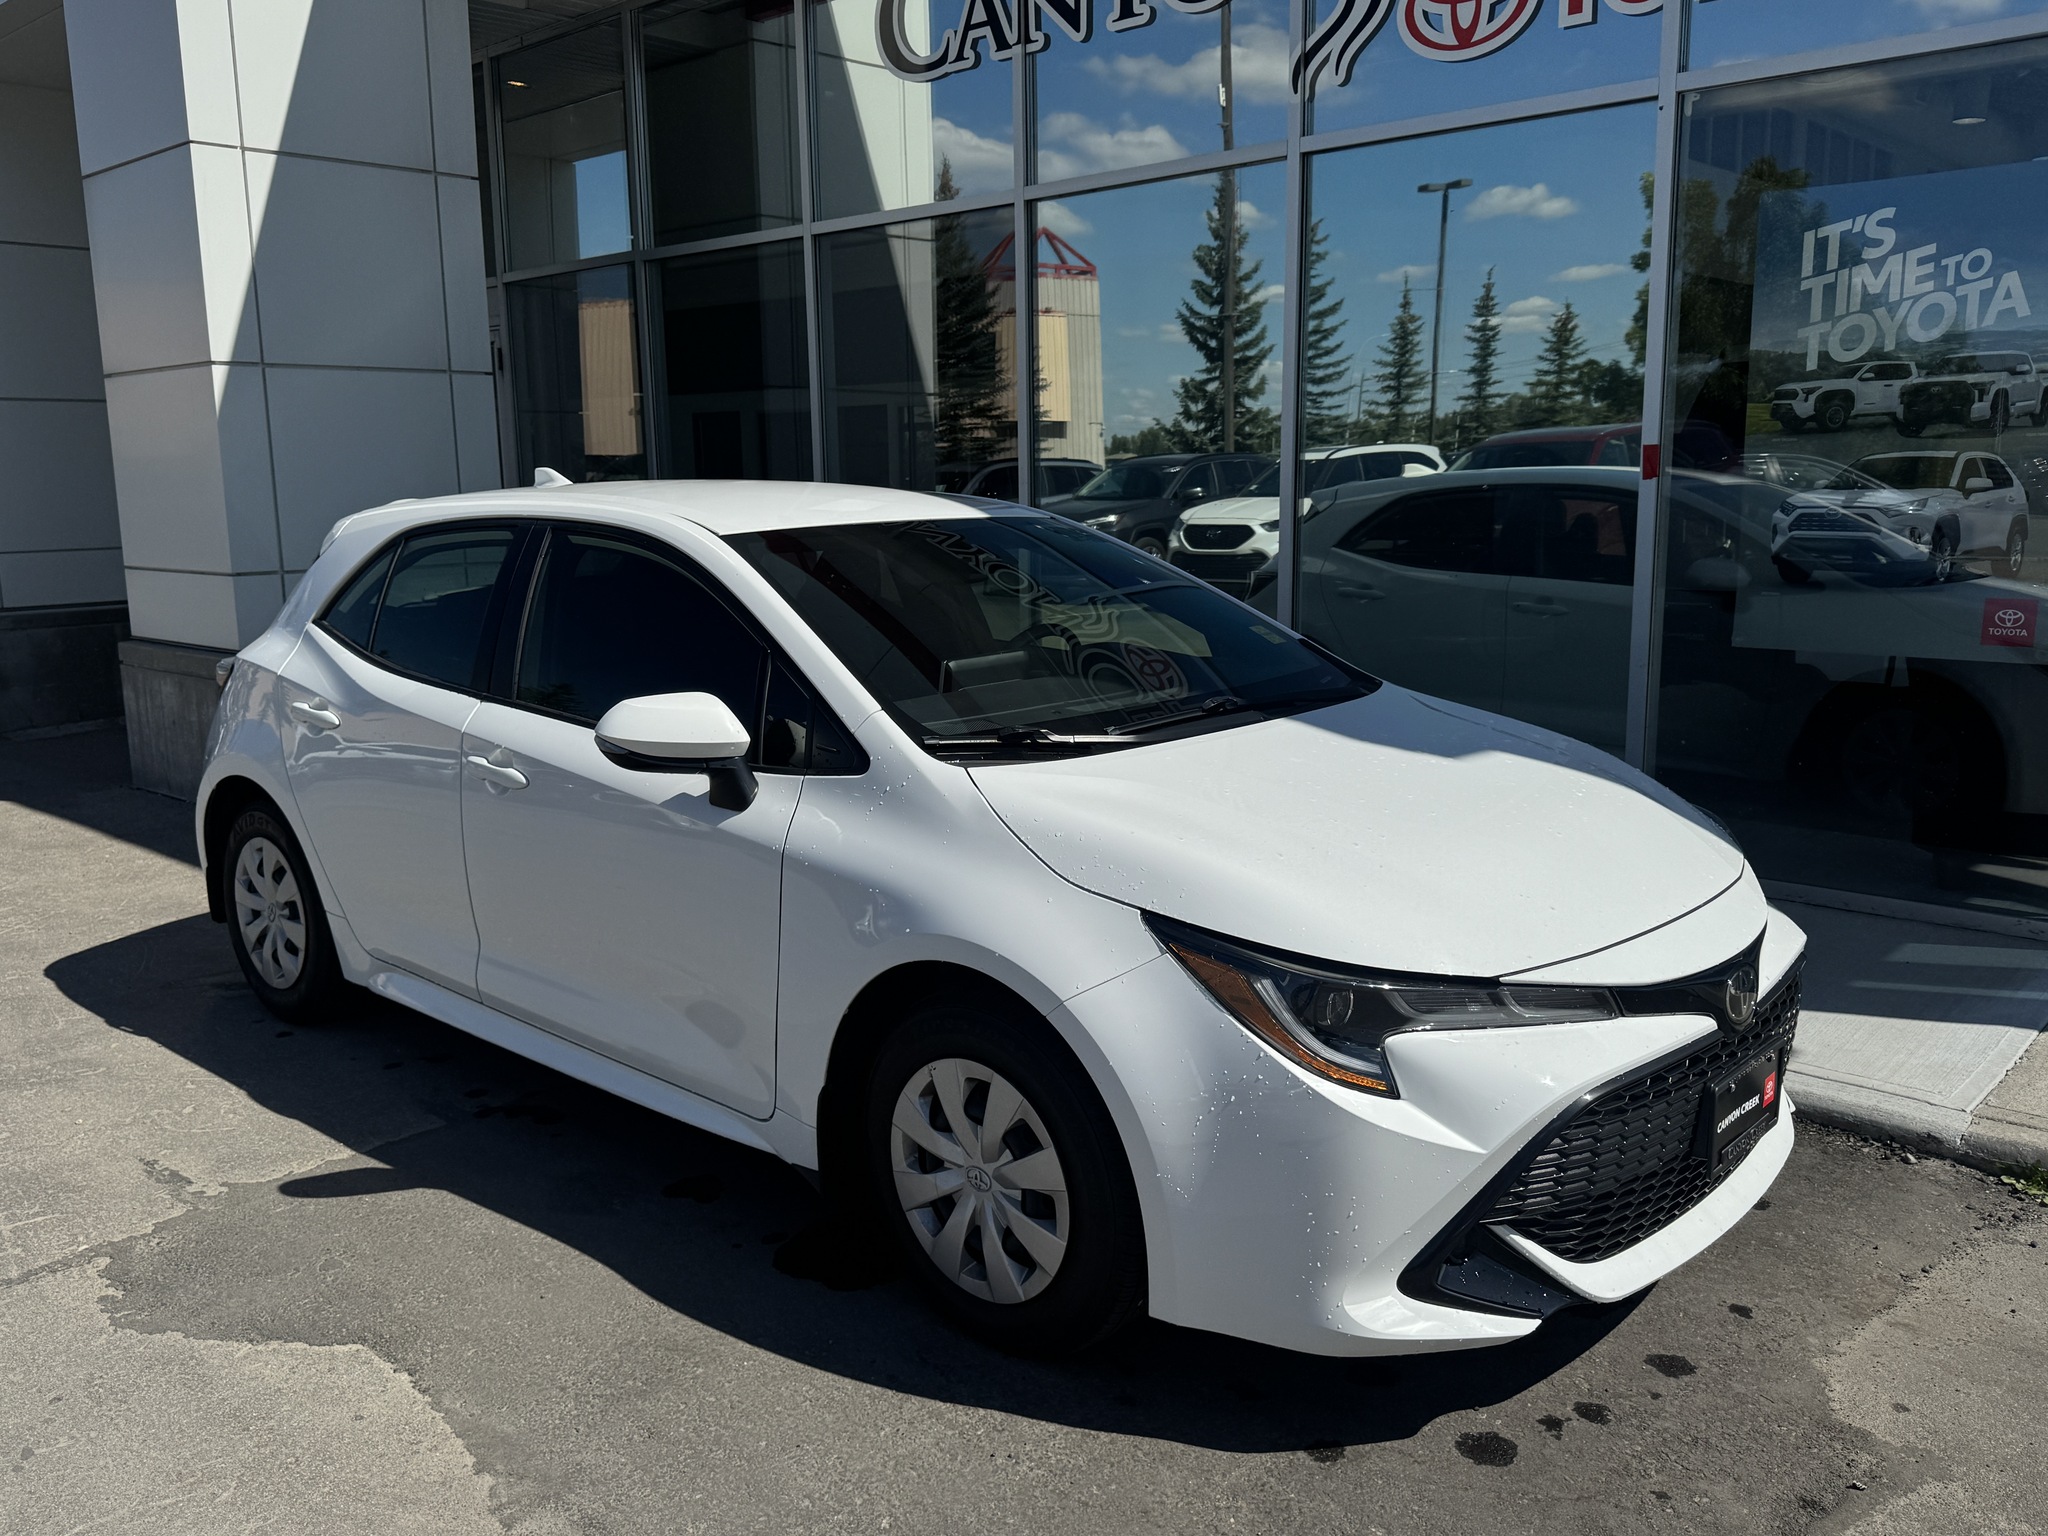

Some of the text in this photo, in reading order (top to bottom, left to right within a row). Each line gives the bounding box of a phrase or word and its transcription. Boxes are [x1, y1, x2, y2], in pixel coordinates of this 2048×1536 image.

[1801, 206, 1897, 279] IT'S
[1800, 242, 1993, 323] TIME TO
[1797, 270, 2032, 372] TOYOTA
[1988, 627, 2028, 637] TOYOTA
[1717, 1106, 1741, 1134] CANYON
[1740, 1093, 1760, 1115] CREEK
